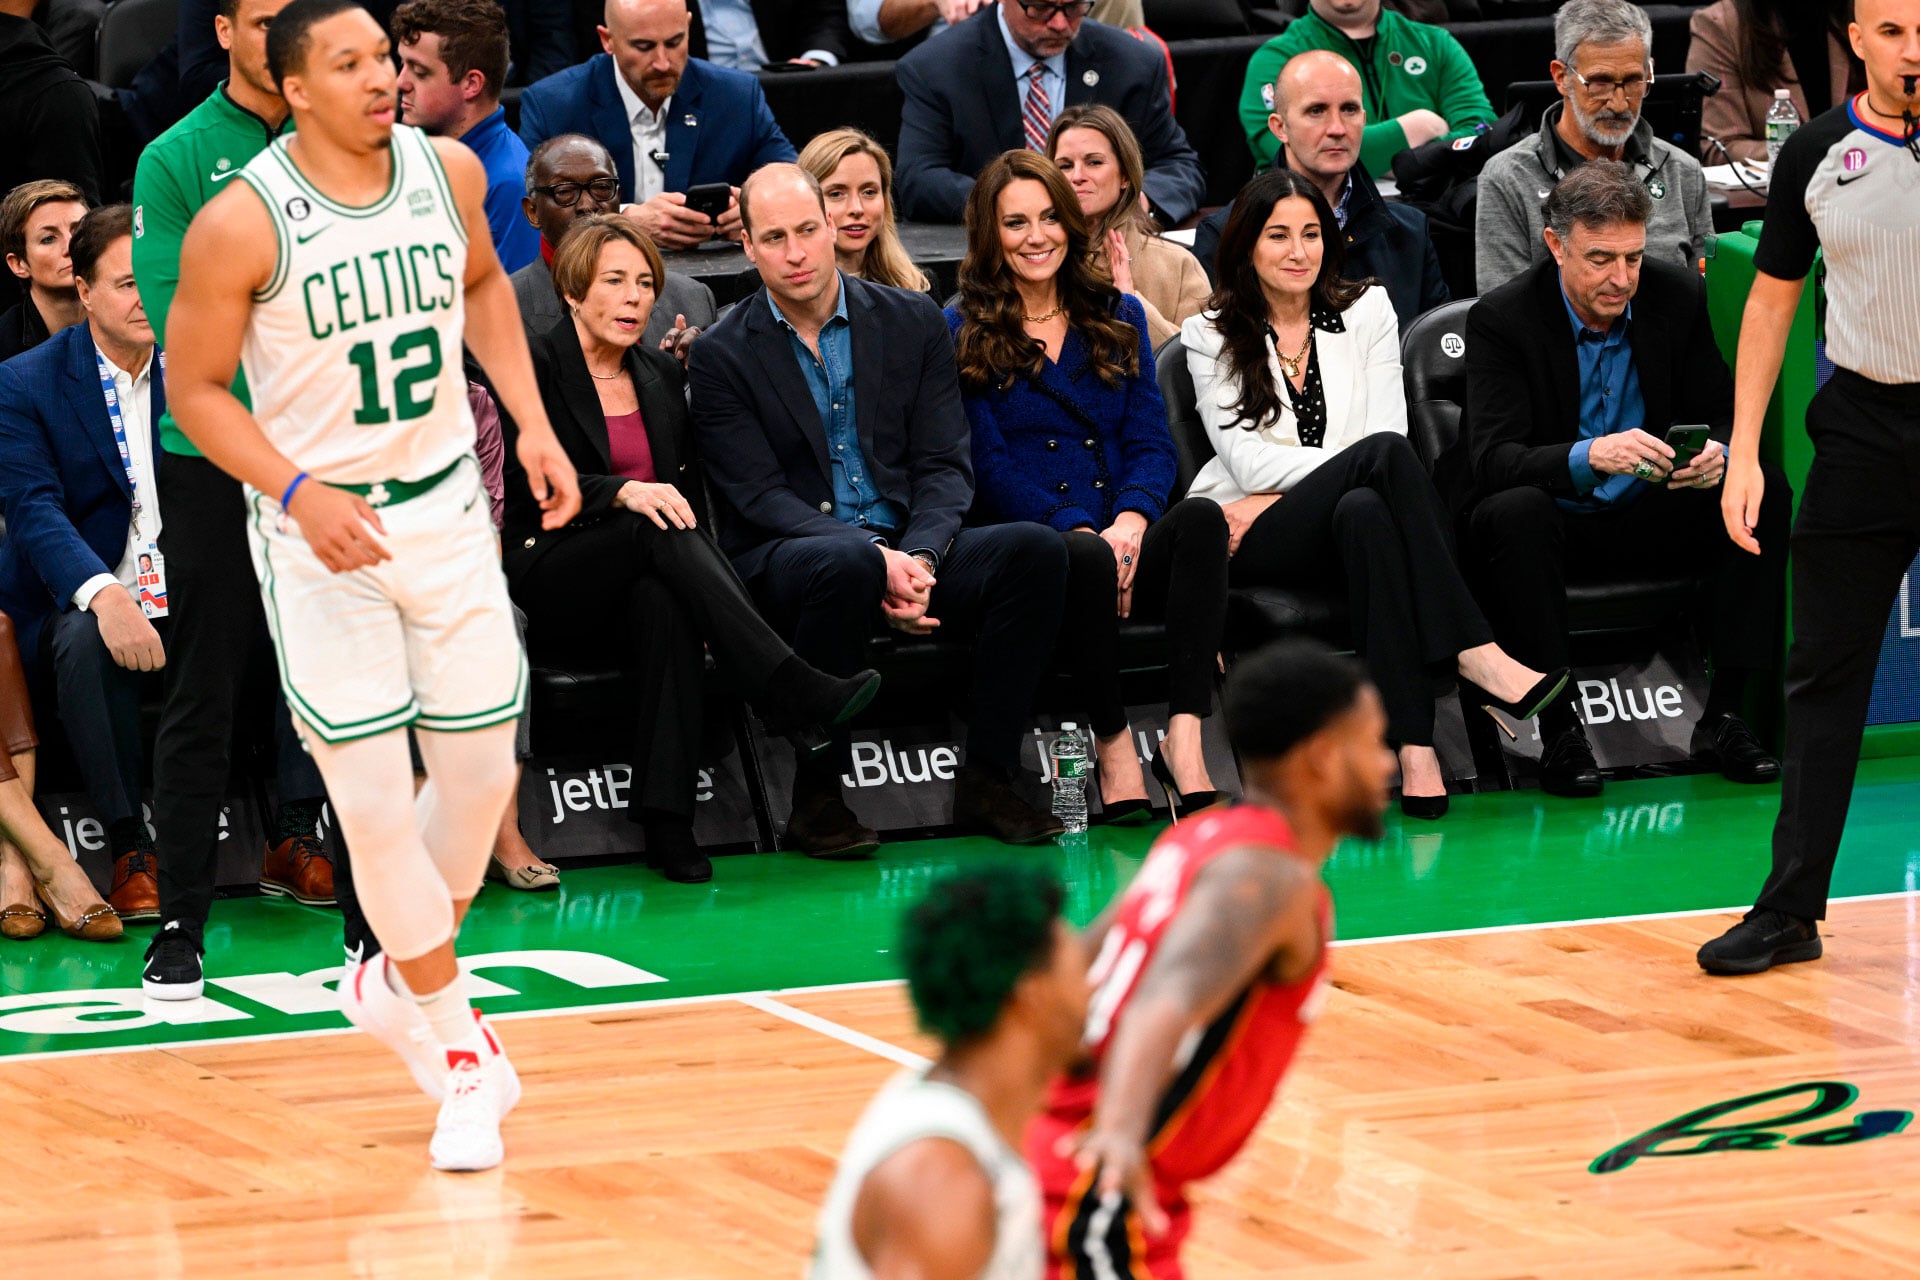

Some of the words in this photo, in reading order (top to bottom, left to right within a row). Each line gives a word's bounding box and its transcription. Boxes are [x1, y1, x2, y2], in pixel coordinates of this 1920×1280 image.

[290, 199, 308, 220] 6
[303, 243, 455, 340] CELTICS
[348, 325, 443, 425] 12
[547, 763, 714, 824] jetBe
[842, 740, 958, 788] Blue
